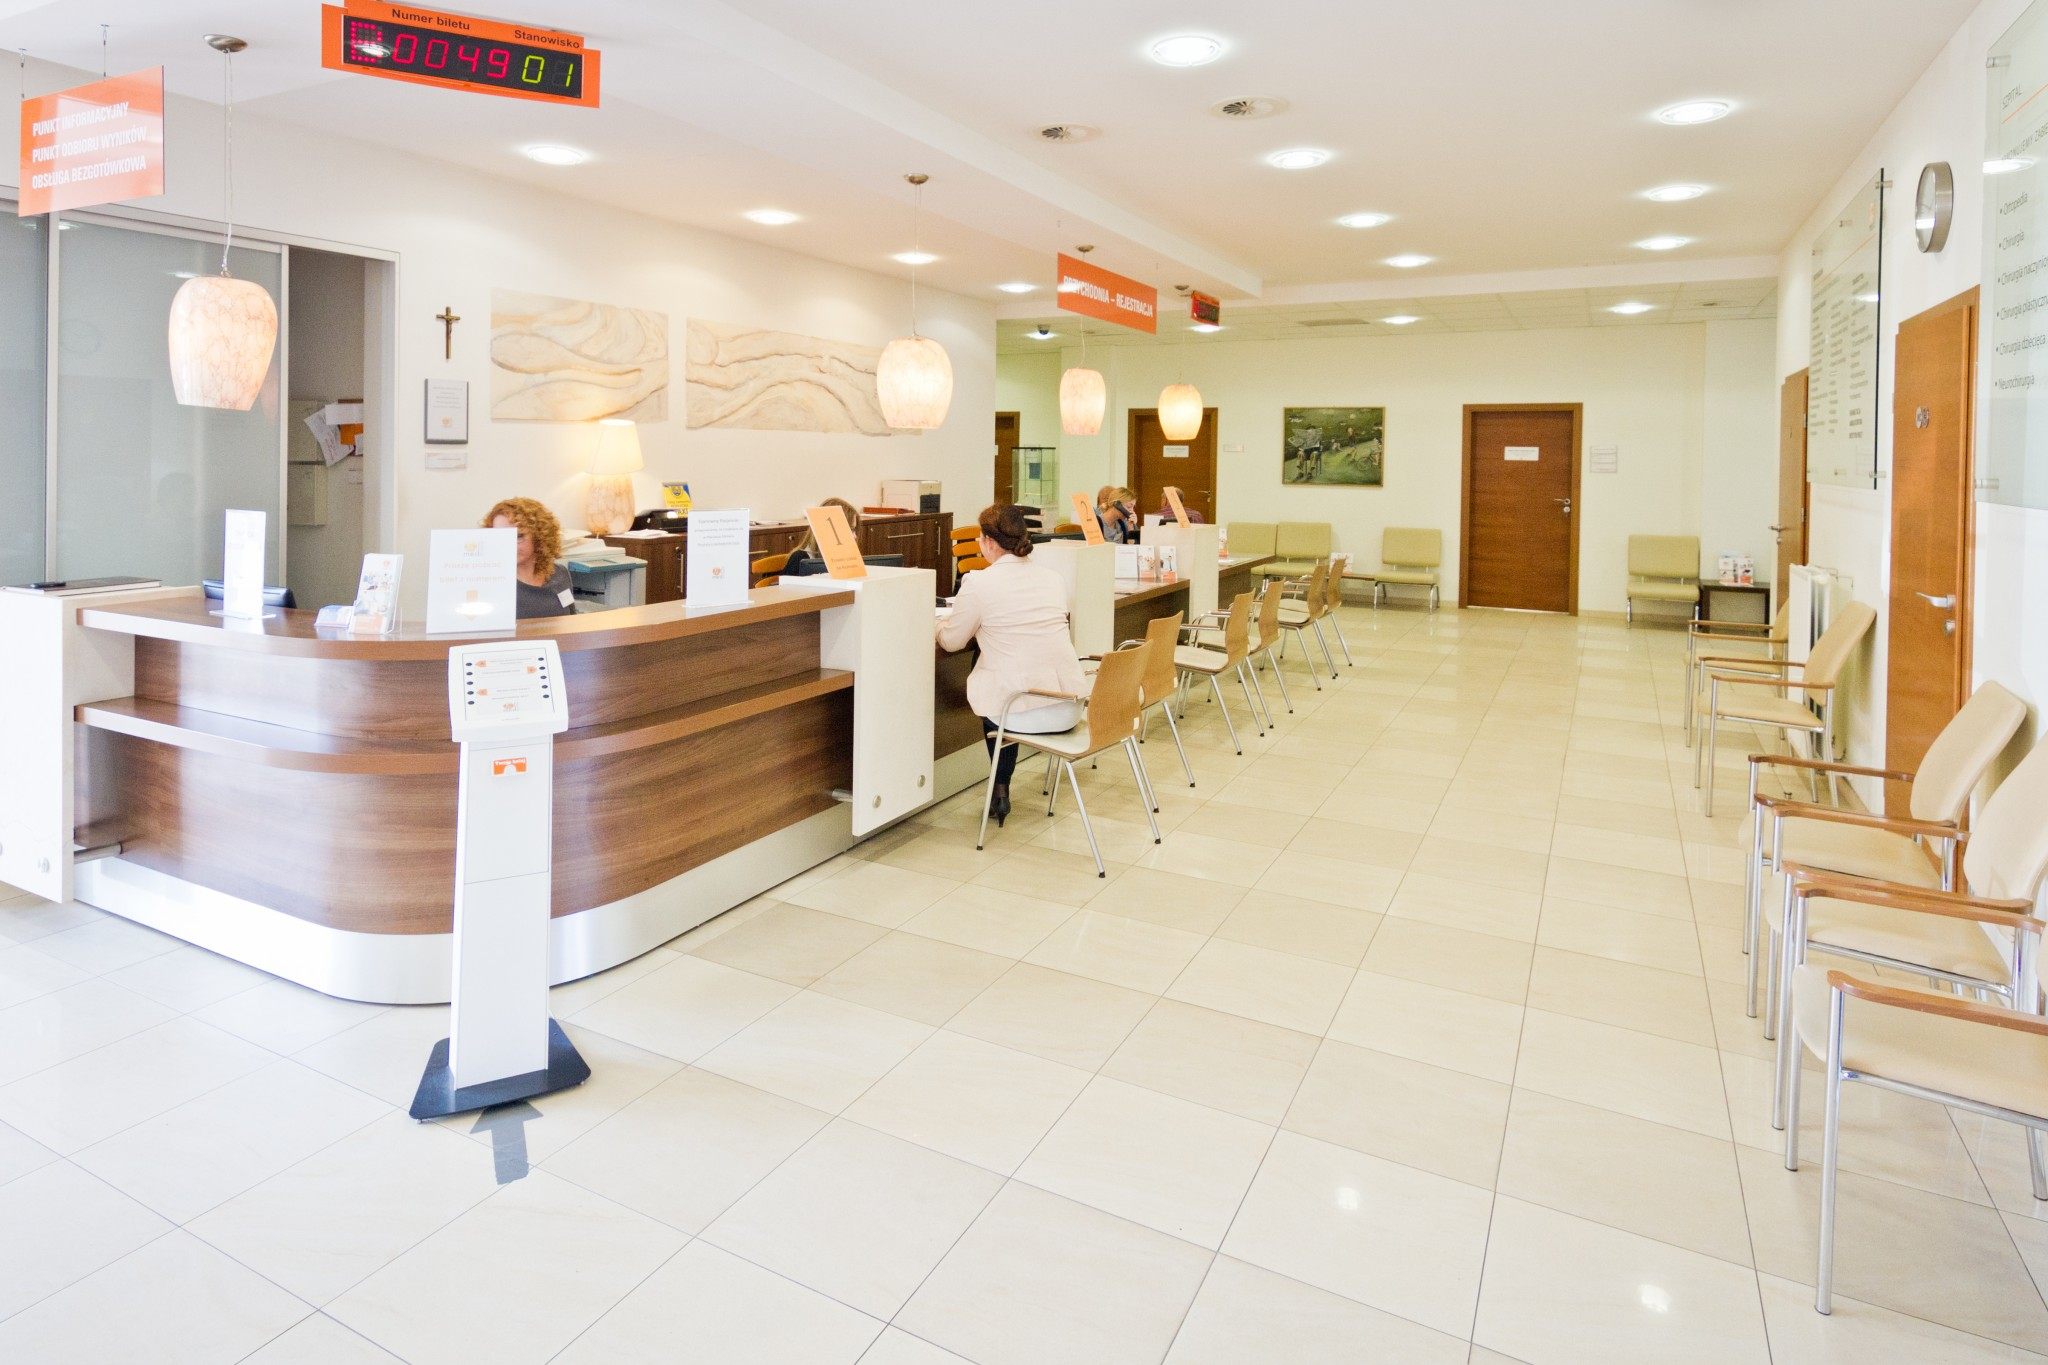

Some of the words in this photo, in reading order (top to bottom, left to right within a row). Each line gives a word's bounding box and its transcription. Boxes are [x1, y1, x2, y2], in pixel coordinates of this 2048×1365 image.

[391, 8, 434, 25] Numer
[436, 16, 471, 31] biletu
[514, 29, 580, 49] Stanowisko
[32, 117, 60, 137] PUNKT
[61, 101, 129, 130] INFORMACYJNY
[32, 144, 60, 163] PUNKT
[61, 136, 100, 157] ODBIORU
[101, 124, 147, 150] WYNIKÓW
[32, 168, 70, 190] OBSŁUGA
[70, 155, 147, 182] BEZGOTÓWKOWA
[2003, 191, 2028, 216] Ortopedia
[2002, 231, 2025, 251] Chirurgia
[2000, 267, 2023, 286] Chirurgia
[1116, 292, 1154, 318] REJESTRACJA
[2000, 303, 2022, 320] Chirurgia
[1999, 339, 2021, 356] Chirurgia
[1998, 374, 2035, 390] Neurochirurgia
[825, 516, 844, 546] 1
